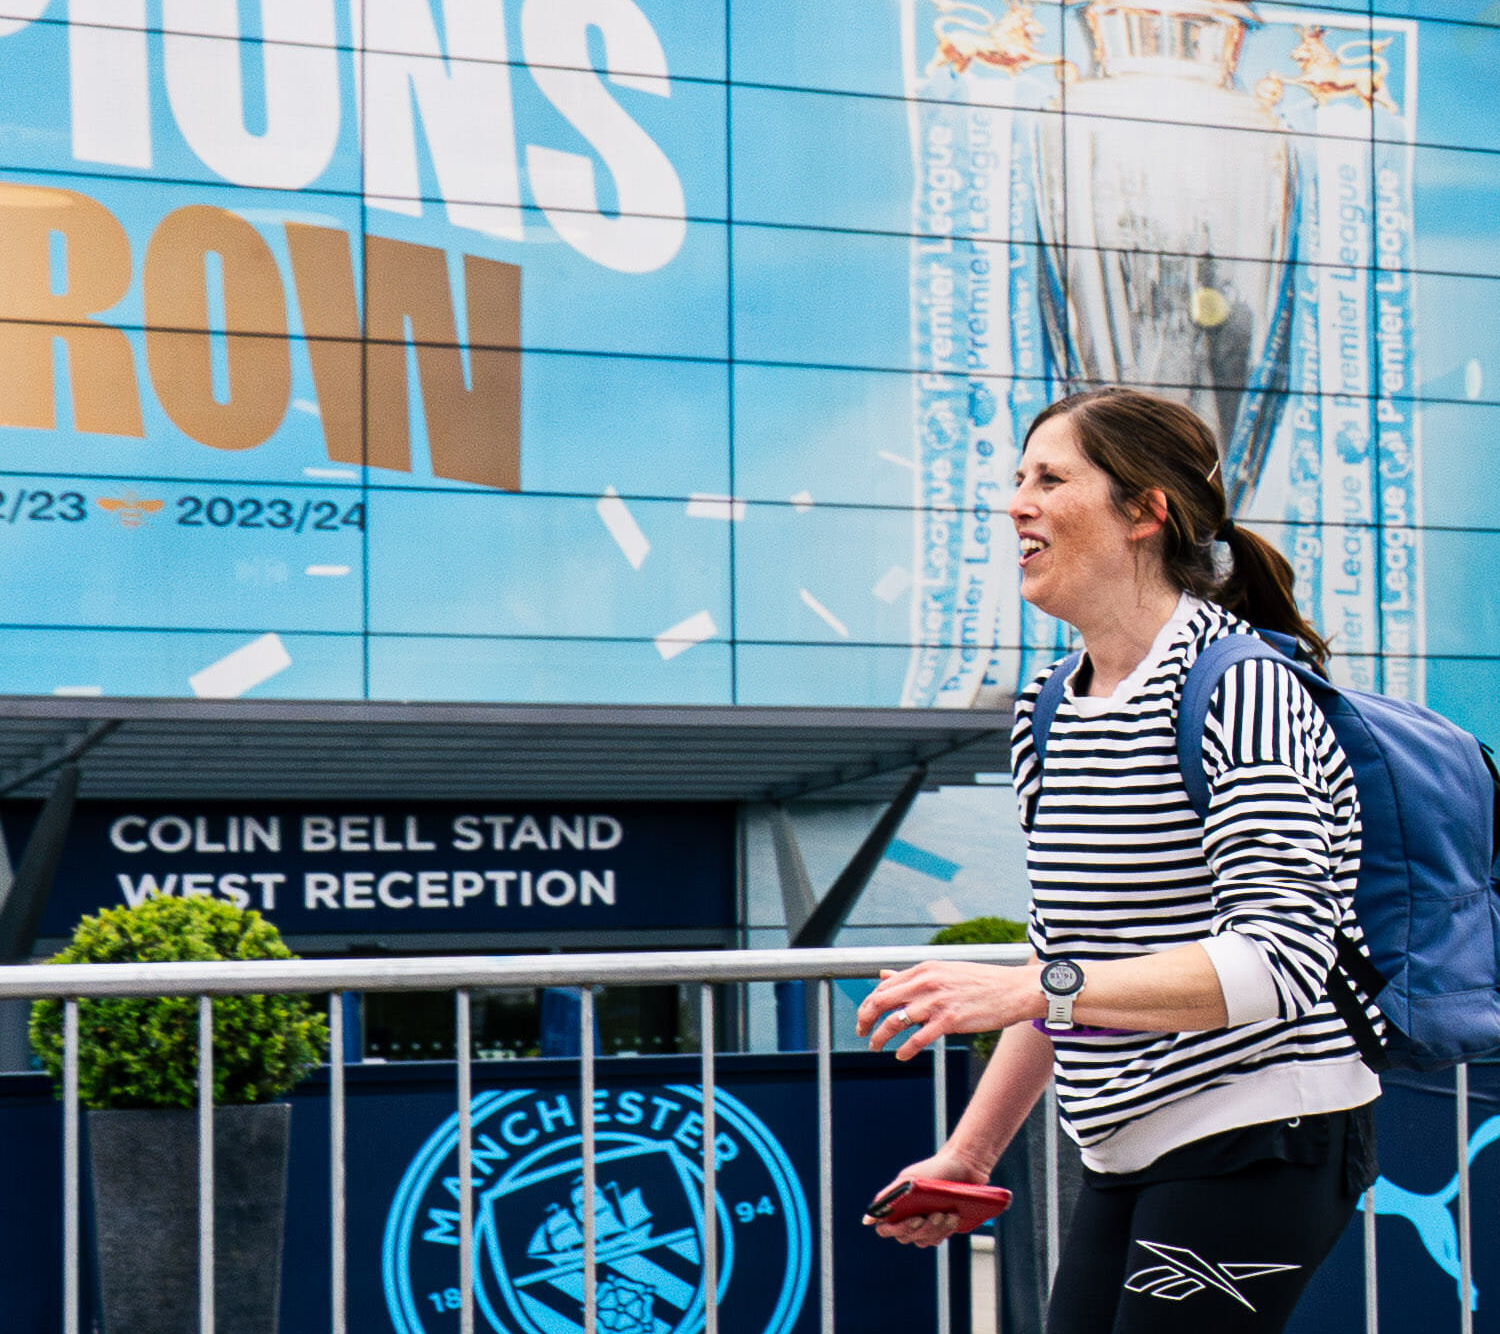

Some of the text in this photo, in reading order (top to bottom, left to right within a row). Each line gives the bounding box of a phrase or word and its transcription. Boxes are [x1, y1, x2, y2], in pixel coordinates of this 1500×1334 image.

[919, 126, 963, 392] Premier League
[1330, 163, 1366, 283] League
[1376, 168, 1408, 424] Premier League
[175, 495, 367, 532] 2023/24
[921, 456, 956, 586] League
[1335, 474, 1373, 596] League
[1380, 484, 1416, 611] League
[109, 814, 624, 853] COLIN BELL STAND
[117, 869, 617, 910] WEST RECEPTION
[422, 1087, 740, 1246] MANCHESTER
[427, 1195, 776, 1314] 18 94
